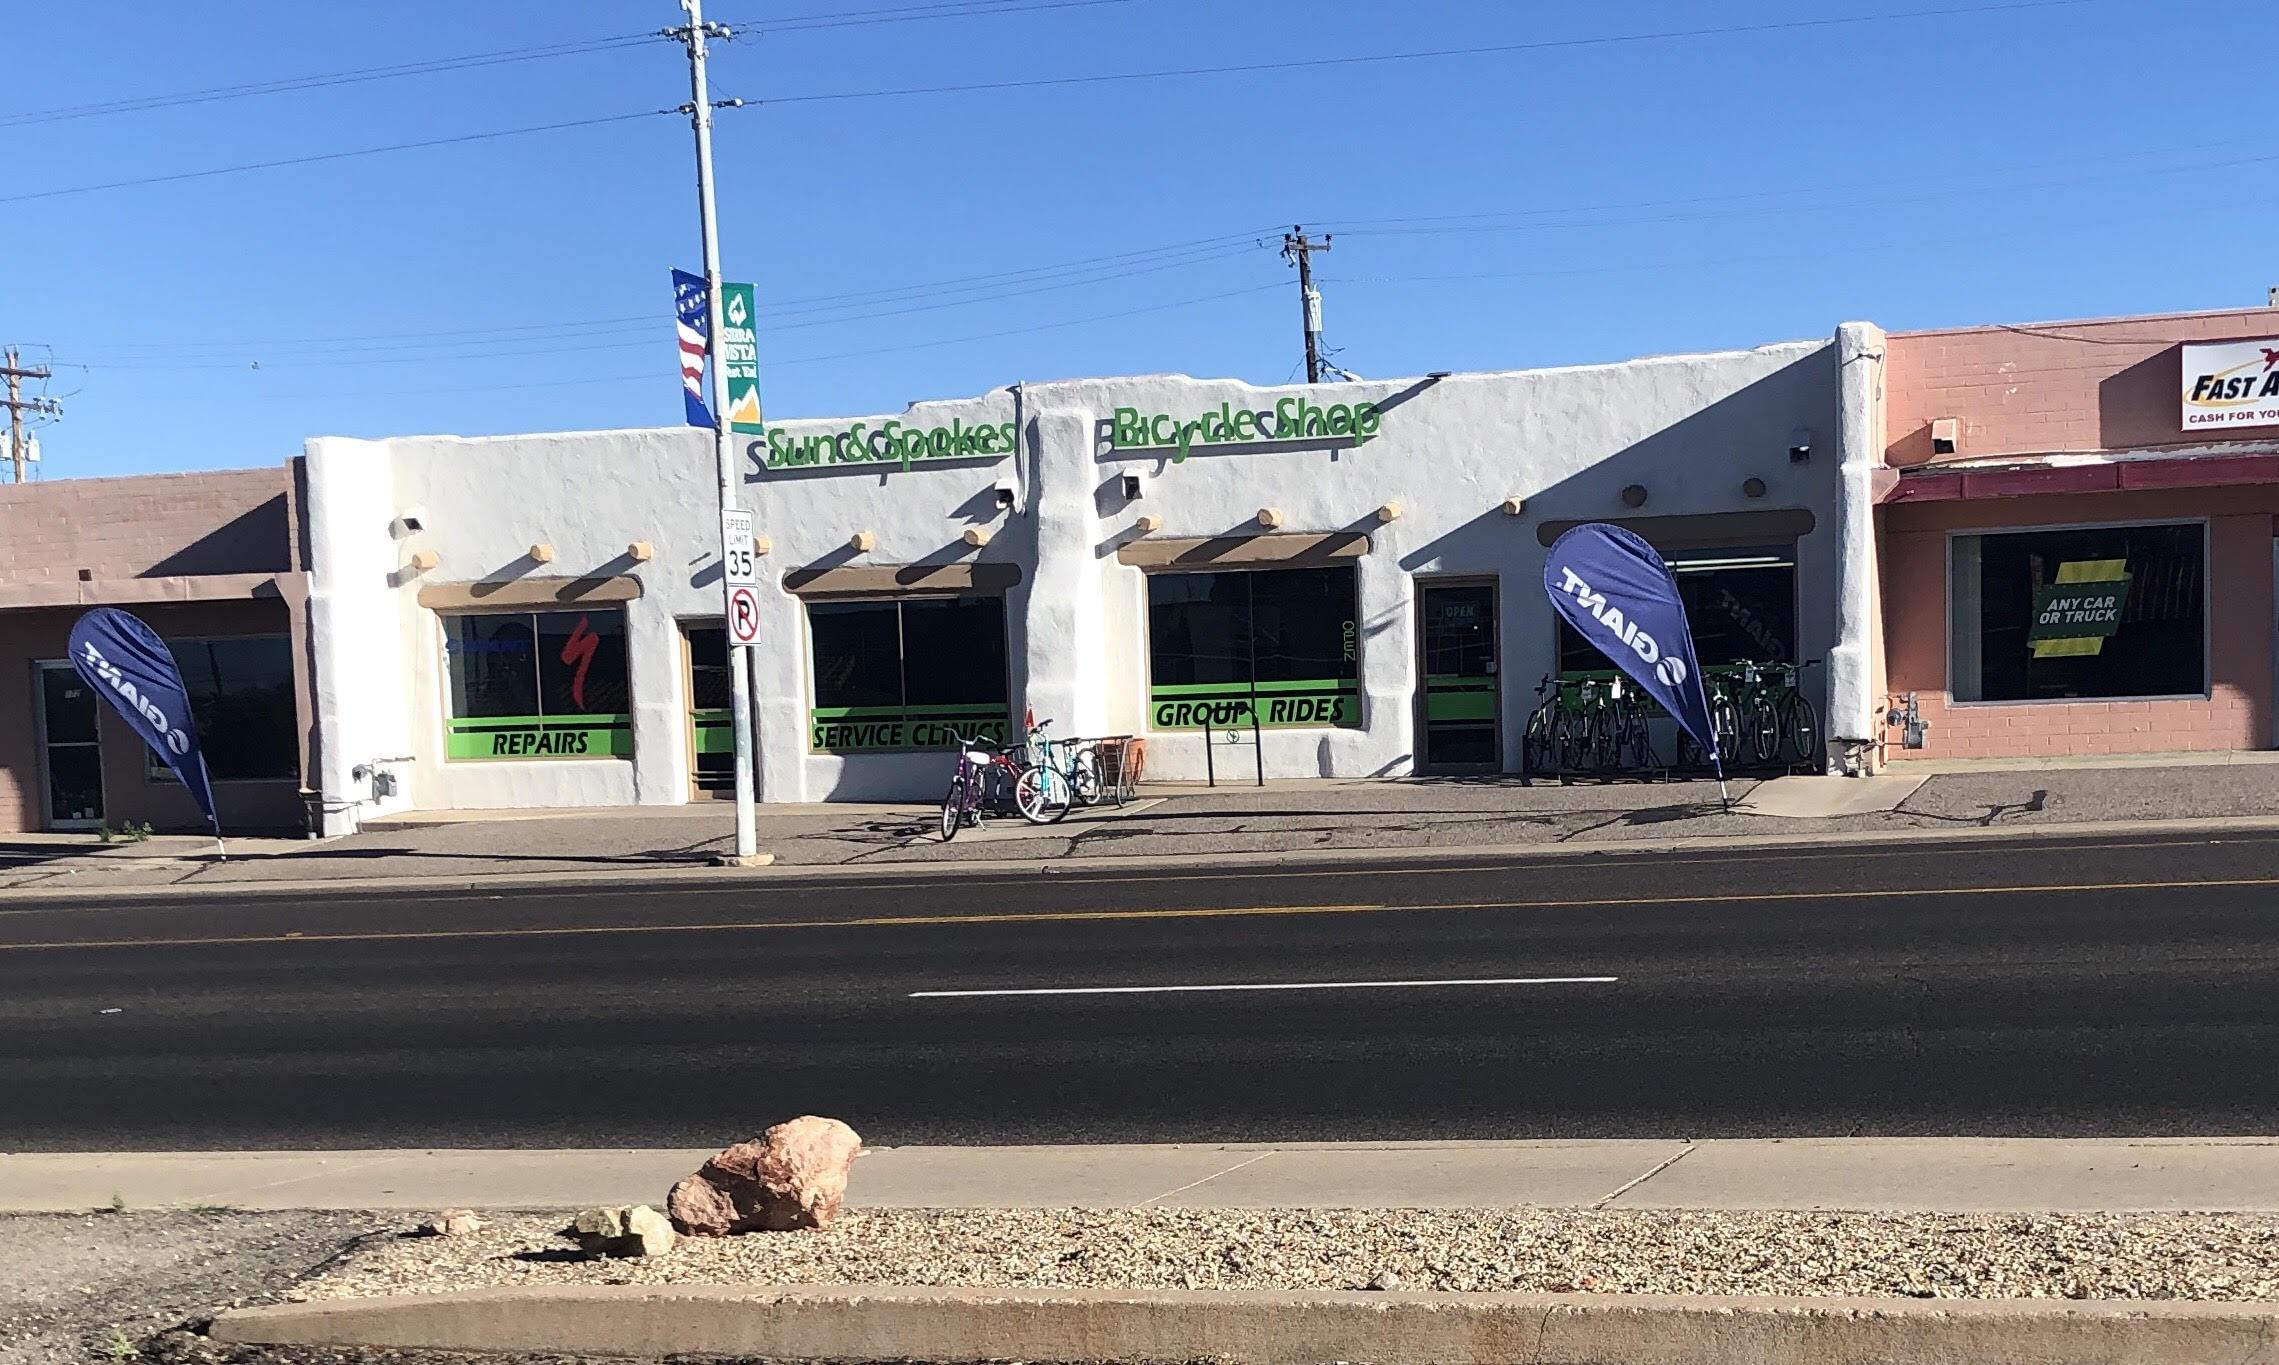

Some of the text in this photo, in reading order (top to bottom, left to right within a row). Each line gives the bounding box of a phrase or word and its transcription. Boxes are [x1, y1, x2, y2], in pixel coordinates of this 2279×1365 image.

[2191, 375, 2258, 401] FAST
[1274, 397, 1380, 447] Shop
[2189, 413, 2225, 424] CASH
[2229, 411, 2255, 421] FOR
[725, 519, 750, 531] SPEED
[728, 535, 749, 546] LIMIT
[728, 549, 752, 576] 35
[1446, 606, 1474, 618] OPEN
[2047, 596, 2116, 612] ANY CAR
[2039, 609, 2118, 625] OR TRUCK
[1342, 620, 1356, 663] OPEN
[1157, 697, 1345, 727] GROUP RIDES
[492, 731, 590, 756] REPAIRS
[813, 721, 1006, 750] SERVICE CLINICS
